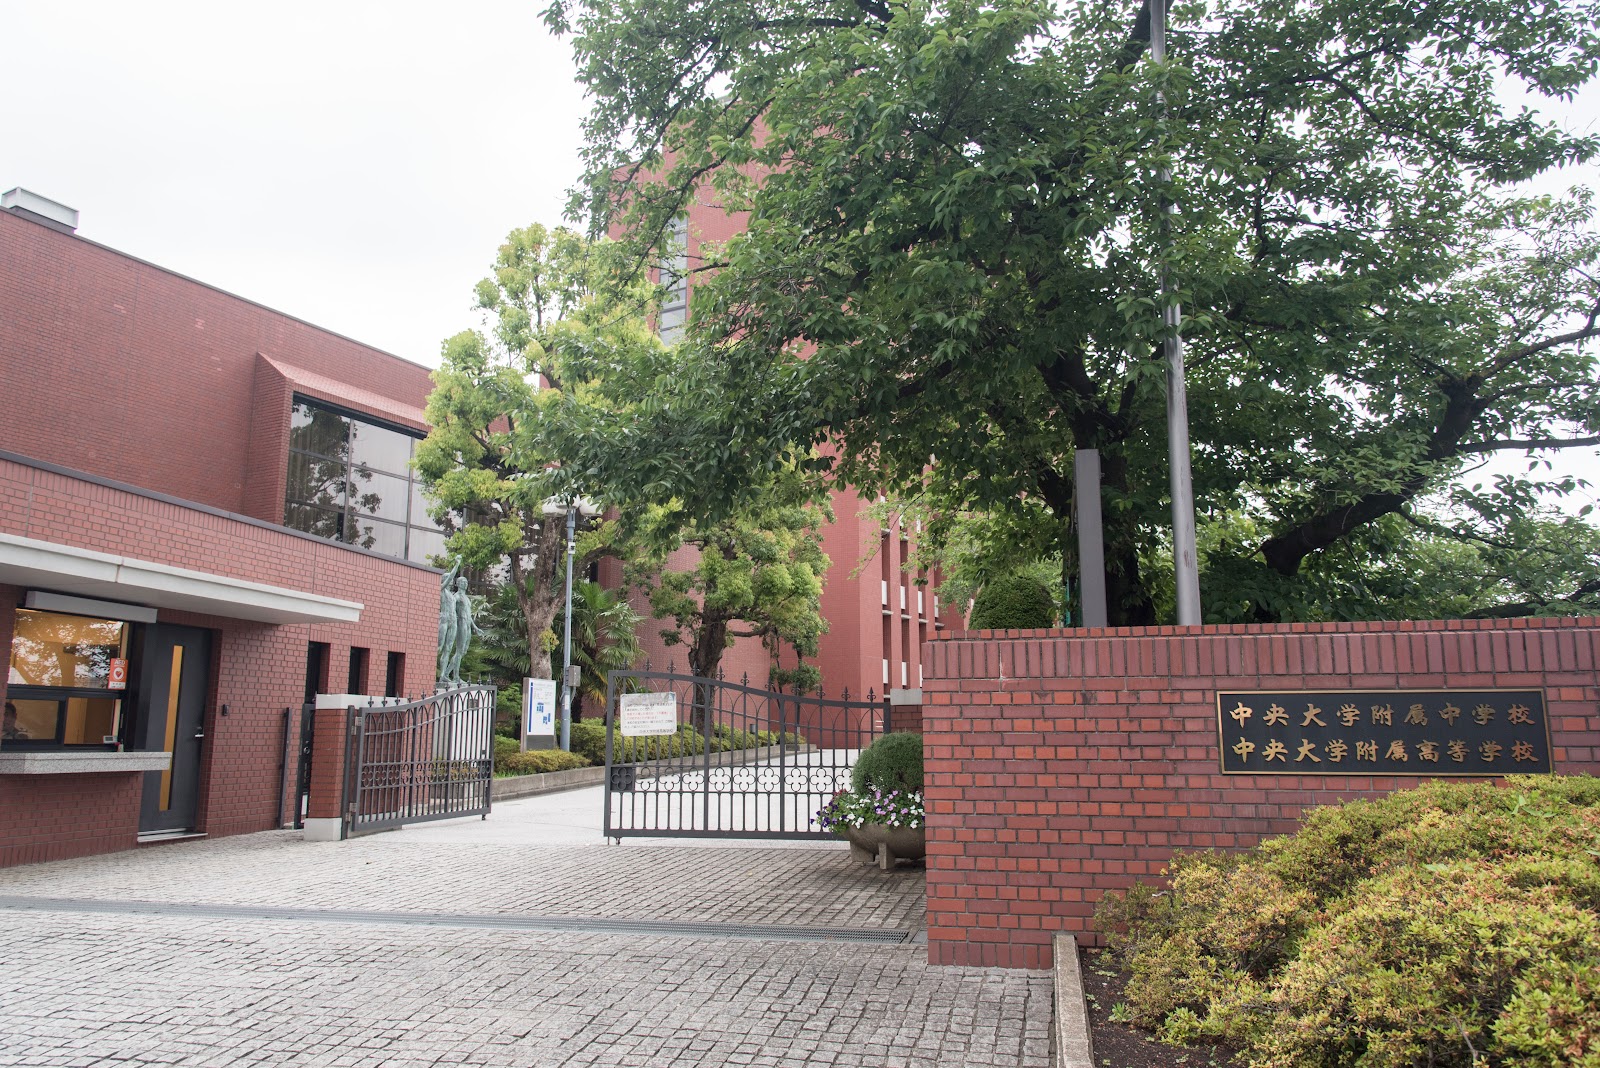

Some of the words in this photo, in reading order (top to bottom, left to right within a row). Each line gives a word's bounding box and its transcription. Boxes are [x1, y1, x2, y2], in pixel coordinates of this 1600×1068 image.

[1230, 702, 1535, 728] 中央大学附属中学校
[1231, 737, 1539, 763] 中央大学附属高等学校
